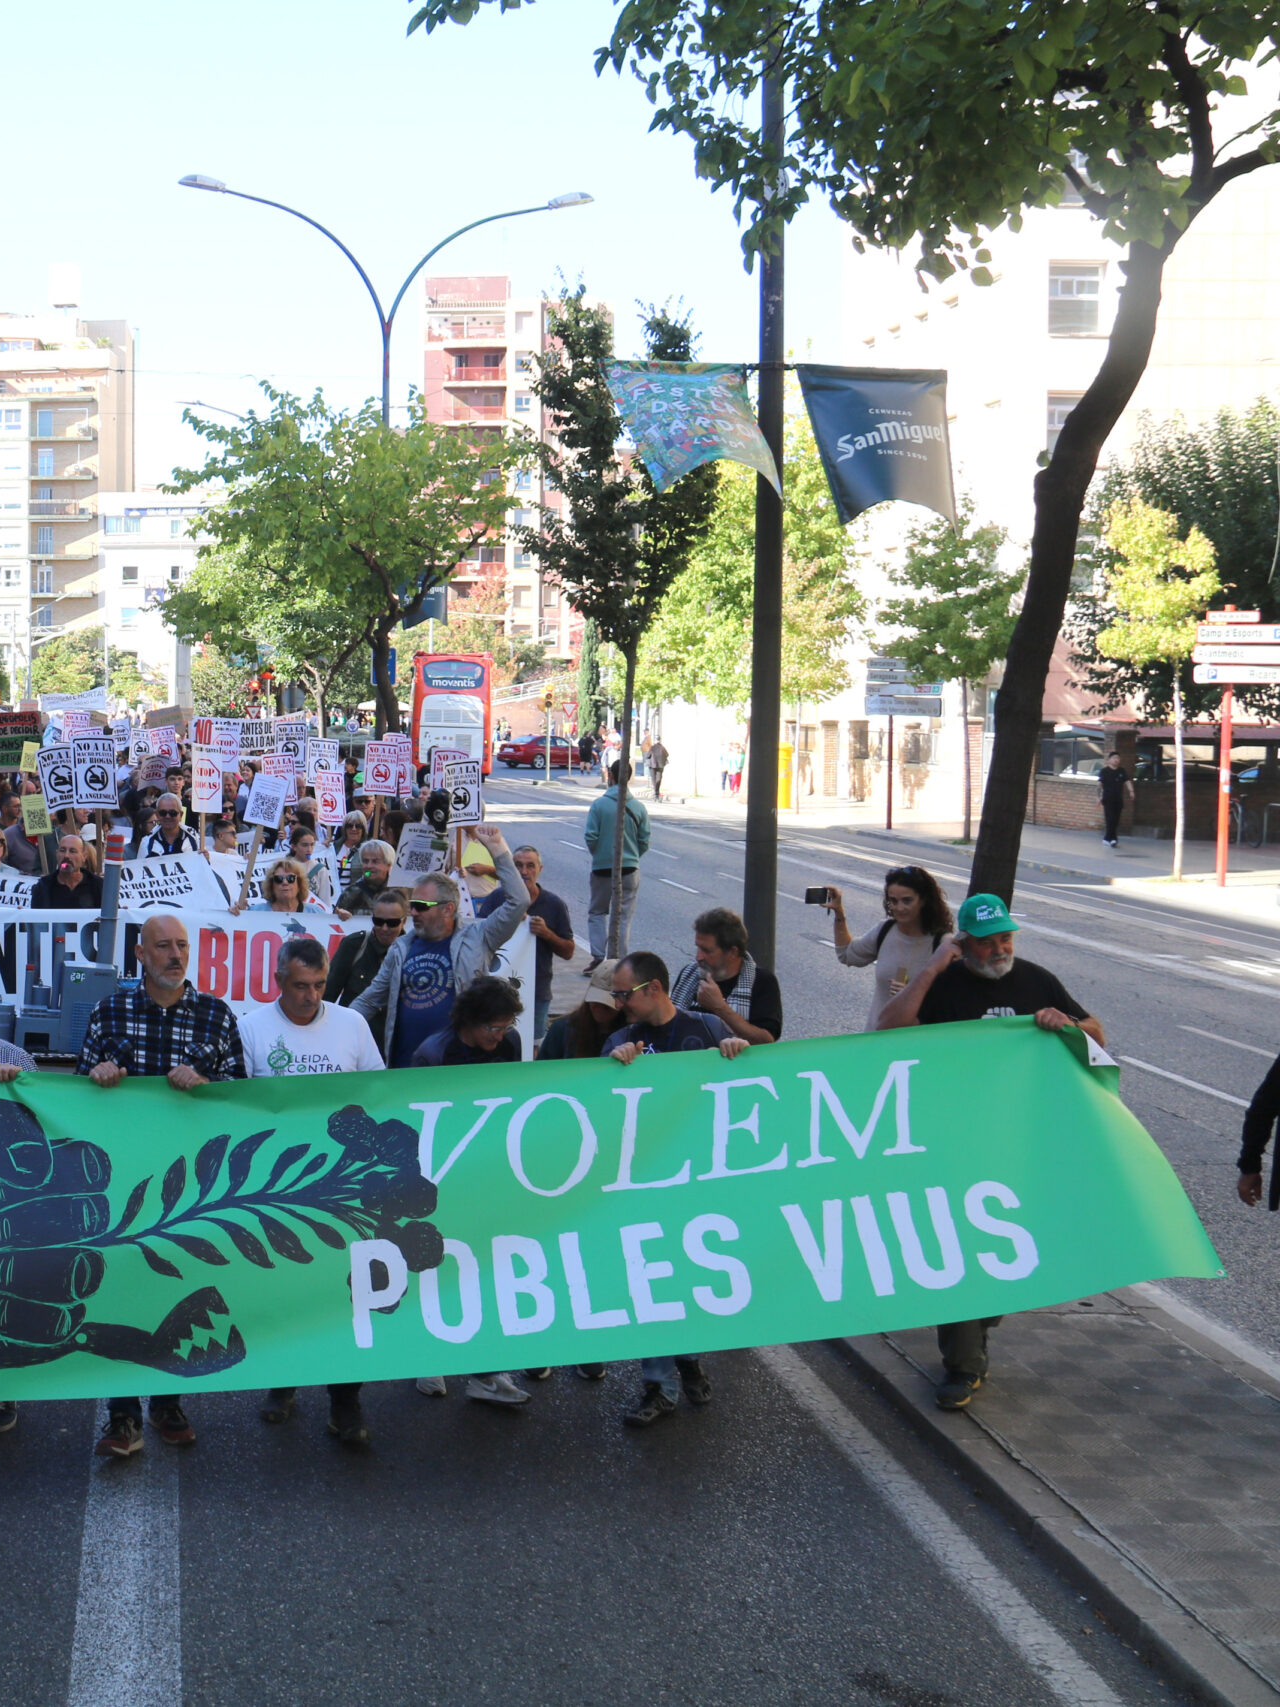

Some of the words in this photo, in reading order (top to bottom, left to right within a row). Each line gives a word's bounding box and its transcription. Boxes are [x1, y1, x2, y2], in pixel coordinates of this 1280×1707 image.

[868, 408, 912, 416] CERVEZAS
[432, 678, 476, 688] movantis
[0, 727, 8, 735] DE
[195, 719, 213, 745] NO
[240, 722, 263, 735] ANTES
[265, 721, 272, 734] DE
[76, 743, 90, 751] NO
[93, 743, 99, 751] A
[102, 743, 112, 751] LA
[41, 754, 53, 763] NO
[196, 768, 215, 776] STOP
[121, 867, 134, 882] O
[141, 865, 155, 879] A
[160, 861, 187, 877] LA
[120, 881, 147, 891] ACRO
[149, 875, 190, 888] PLANTA
[134, 883, 193, 900] BIOGAS
[408, 1059, 926, 1198] VOLEM
[349, 1213, 752, 1349] POBLES
[780, 1180, 1039, 1302] VIUS
